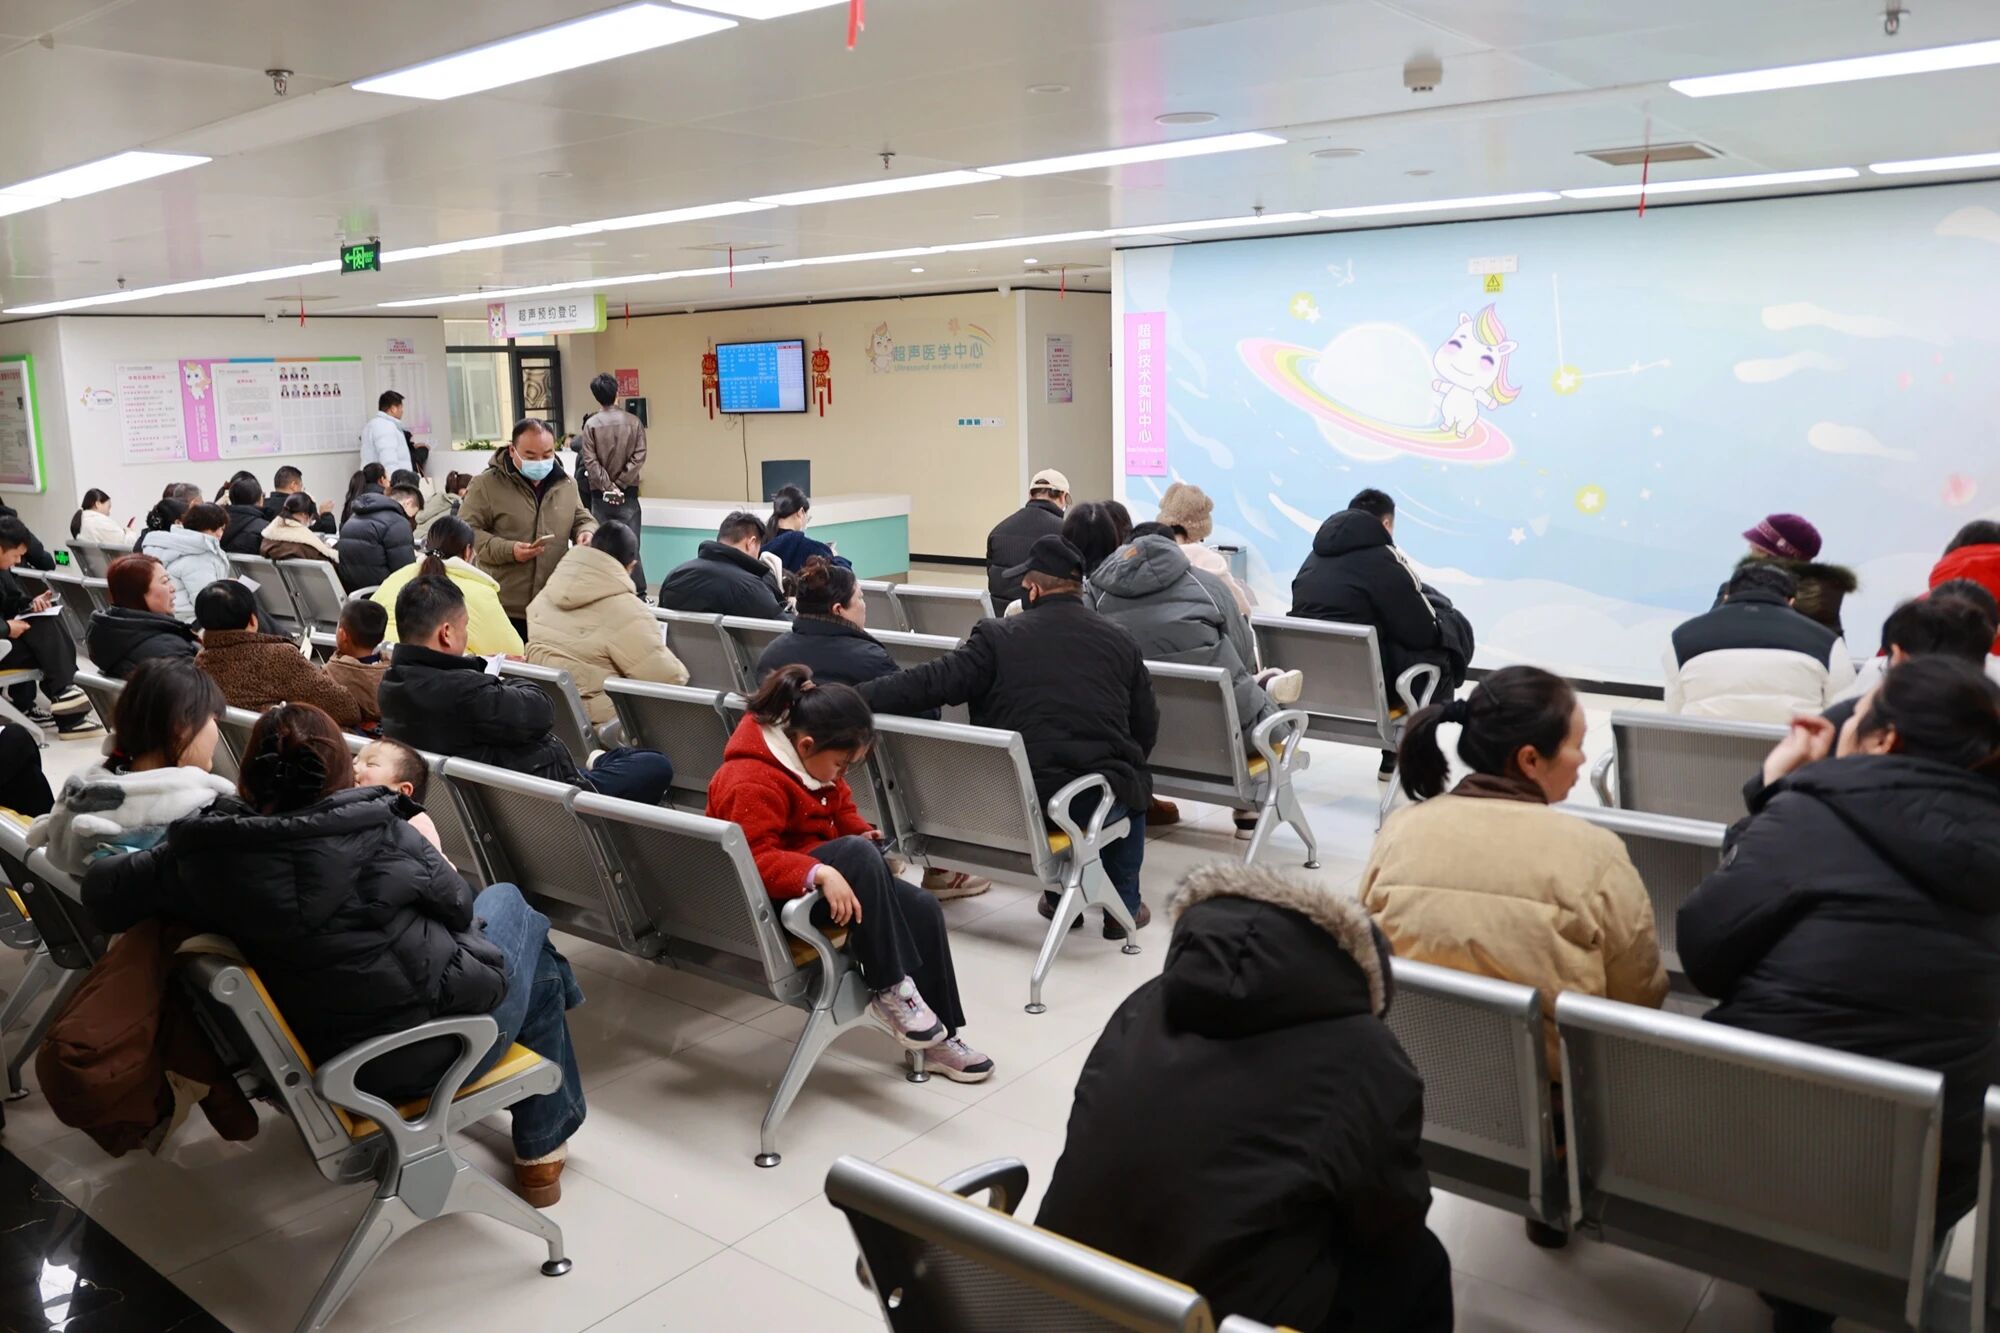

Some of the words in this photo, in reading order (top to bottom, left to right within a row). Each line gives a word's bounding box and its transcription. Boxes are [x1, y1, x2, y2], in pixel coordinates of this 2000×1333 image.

[518, 305, 577, 321] 超声预约登记
[894, 342, 983, 361] 超声医学中心
[1137, 323, 1152, 442] 超声技术实训中心
